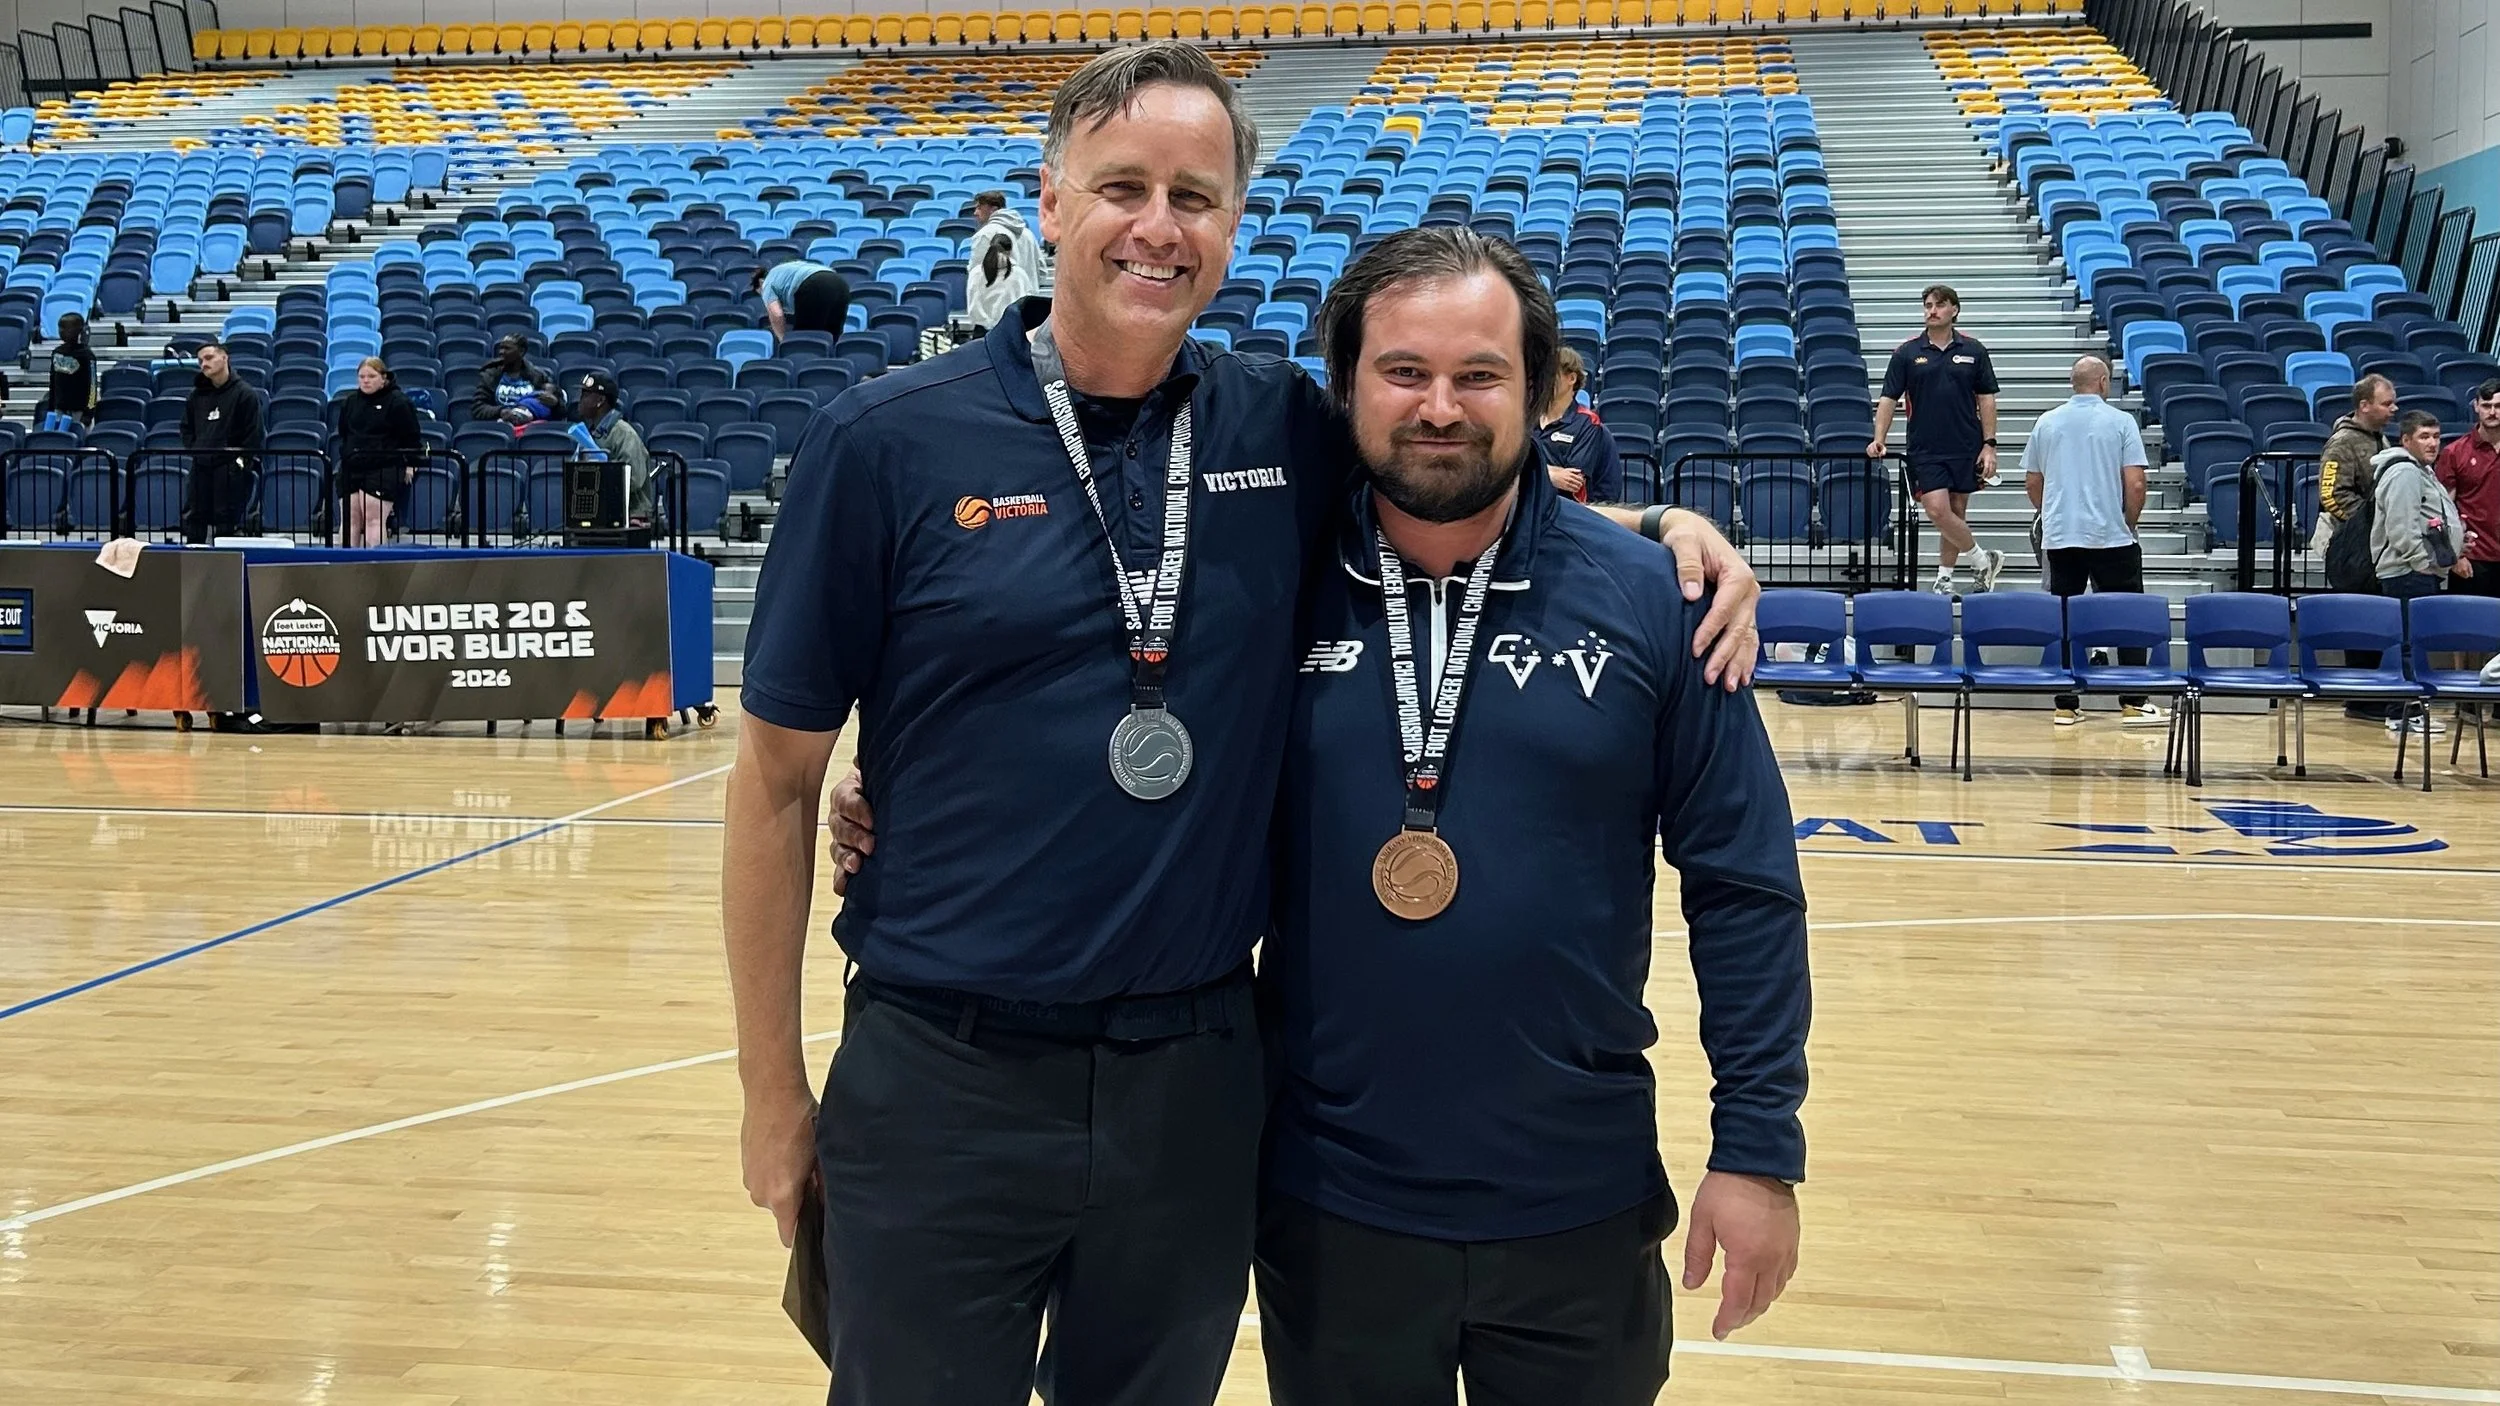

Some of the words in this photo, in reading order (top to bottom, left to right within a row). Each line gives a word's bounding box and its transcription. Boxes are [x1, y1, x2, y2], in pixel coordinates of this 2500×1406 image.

[1043, 379, 1092, 481] CHAMPIONSHIPS
[1202, 466, 1288, 493] VICTORIA
[992, 493, 1046, 507] BASKETBALL
[994, 503, 1049, 520] VICTORIA
[1163, 486, 1189, 547] NATIONAL
[1155, 549, 1185, 596] LOCKER
[1379, 551, 1405, 595] LOCKER
[5, 608, 23, 625] OUT
[368, 603, 500, 632] UNDER
[508, 601, 555, 629] 20
[565, 600, 591, 627] &
[1149, 599, 1176, 630] FOOT
[1384, 597, 1413, 658] NATIONAL
[262, 635, 340, 648] NATIONAL
[366, 634, 456, 662] IVOR
[464, 631, 595, 660] BURGE
[1446, 615, 1479, 676] NATIONAL
[451, 669, 512, 688] 2026
[1392, 660, 1424, 763] CHAMPIONSHIPS
[1432, 677, 1463, 724] LOCKER
[1424, 725, 1450, 758] FOOT
